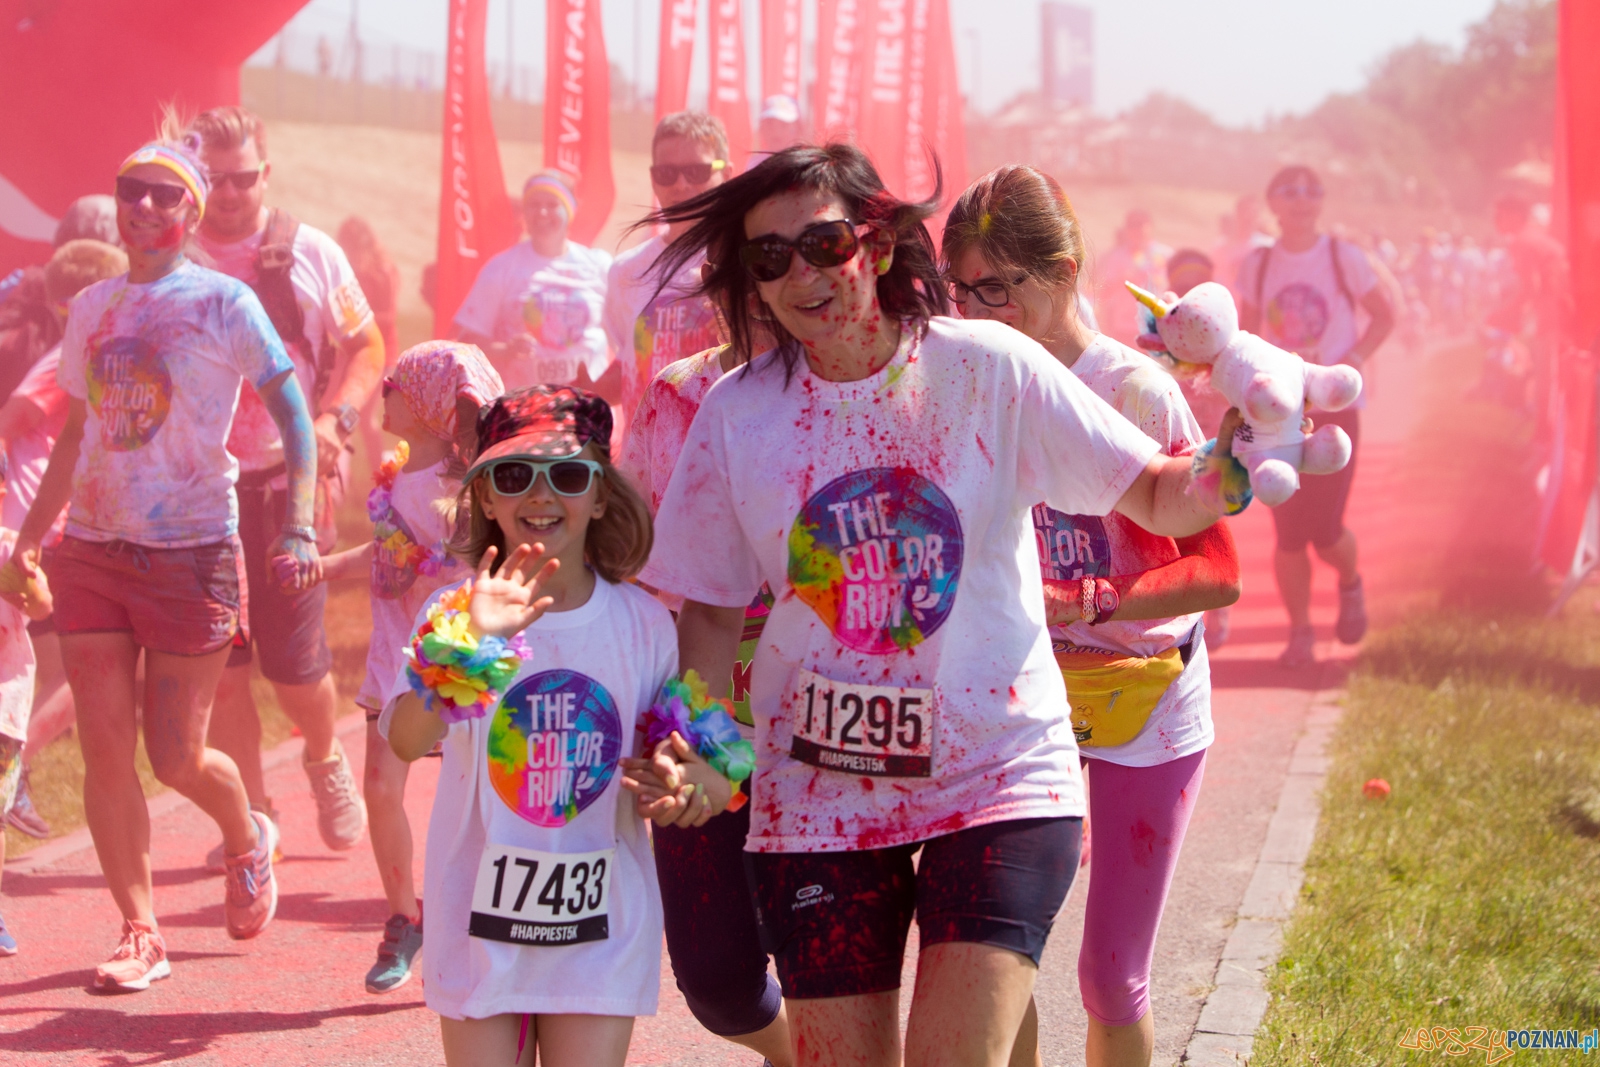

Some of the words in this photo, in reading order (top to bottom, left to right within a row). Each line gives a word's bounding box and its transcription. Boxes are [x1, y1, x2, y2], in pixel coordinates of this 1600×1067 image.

[656, 305, 686, 330] THE
[827, 491, 898, 547] THE
[839, 533, 945, 583] COLOR
[1034, 528, 1095, 567] OLOR
[846, 583, 907, 630] RUN
[526, 693, 576, 730] THE
[805, 682, 923, 749] 11295
[526, 732, 604, 767] COLOR
[819, 748, 887, 773] #HAPPIEST5K
[528, 770, 574, 808] RUN
[491, 854, 607, 916] 17433
[510, 923, 578, 941] #HAPPIEST5K
